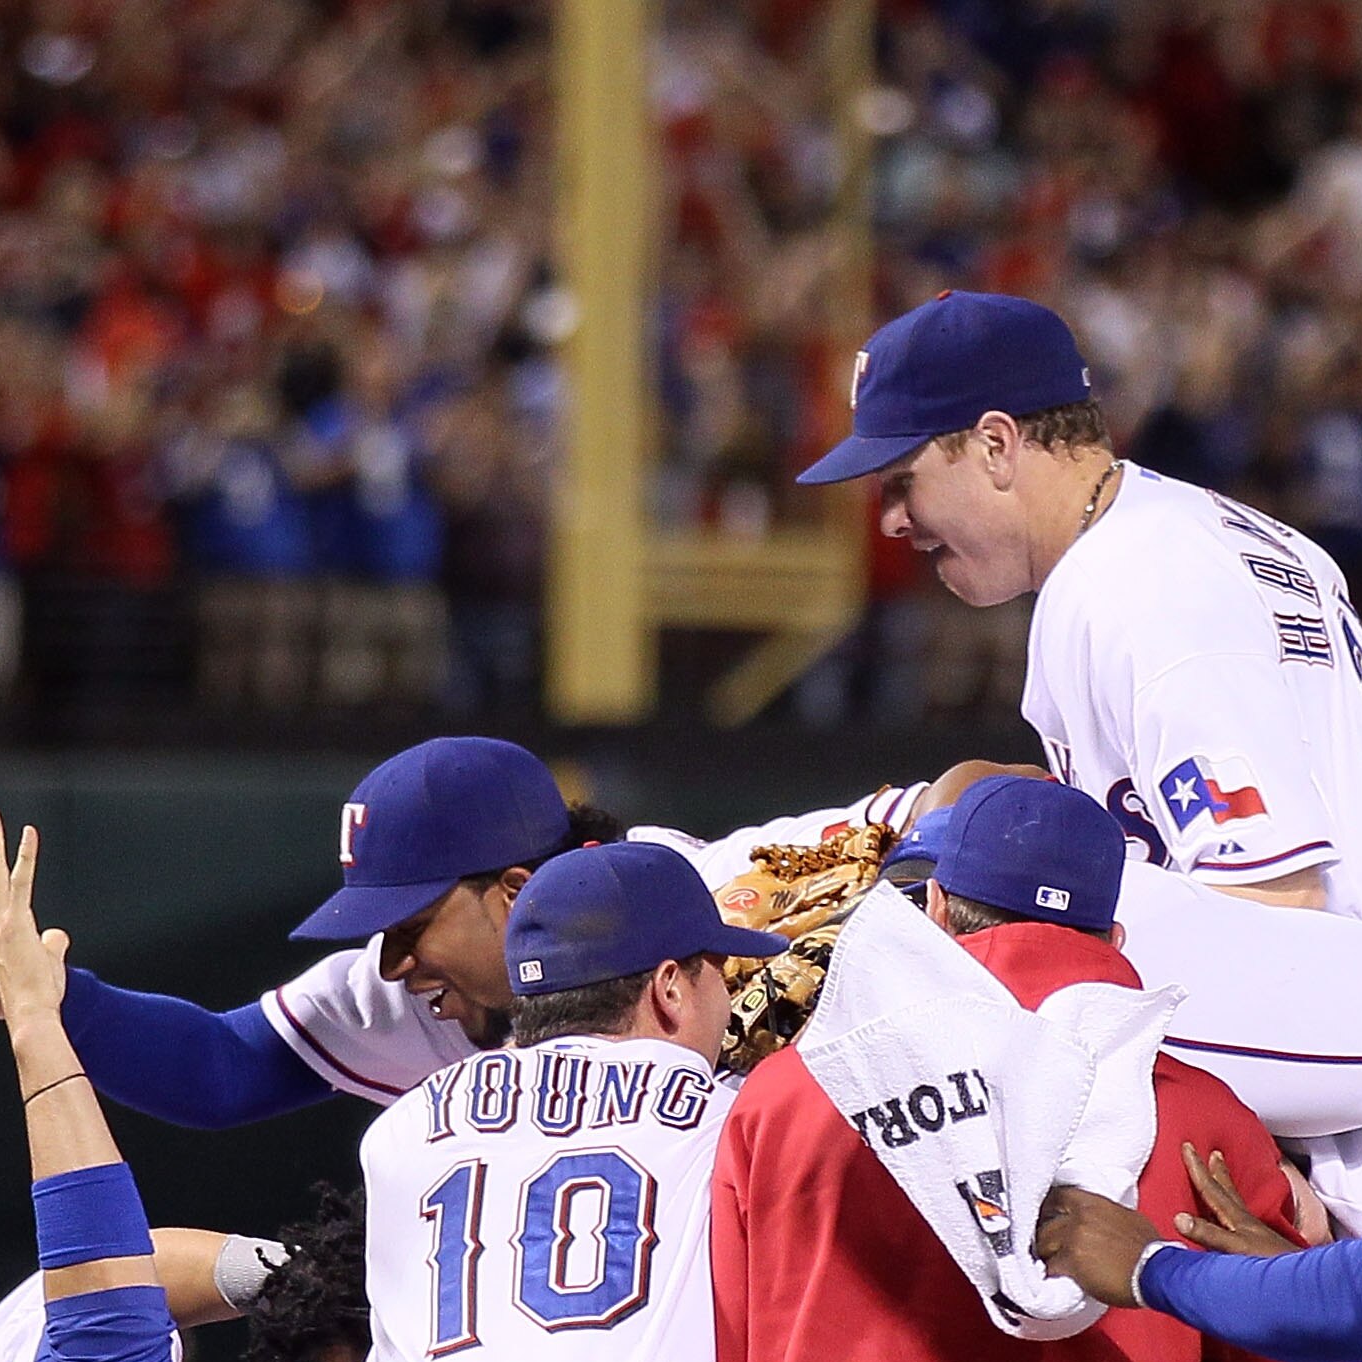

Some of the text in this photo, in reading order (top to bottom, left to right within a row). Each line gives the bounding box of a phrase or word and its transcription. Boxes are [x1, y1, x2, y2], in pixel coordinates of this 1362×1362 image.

[338, 802, 368, 868] T
[423, 1048, 715, 1143] YOUNG
[419, 1145, 659, 1360] 10
